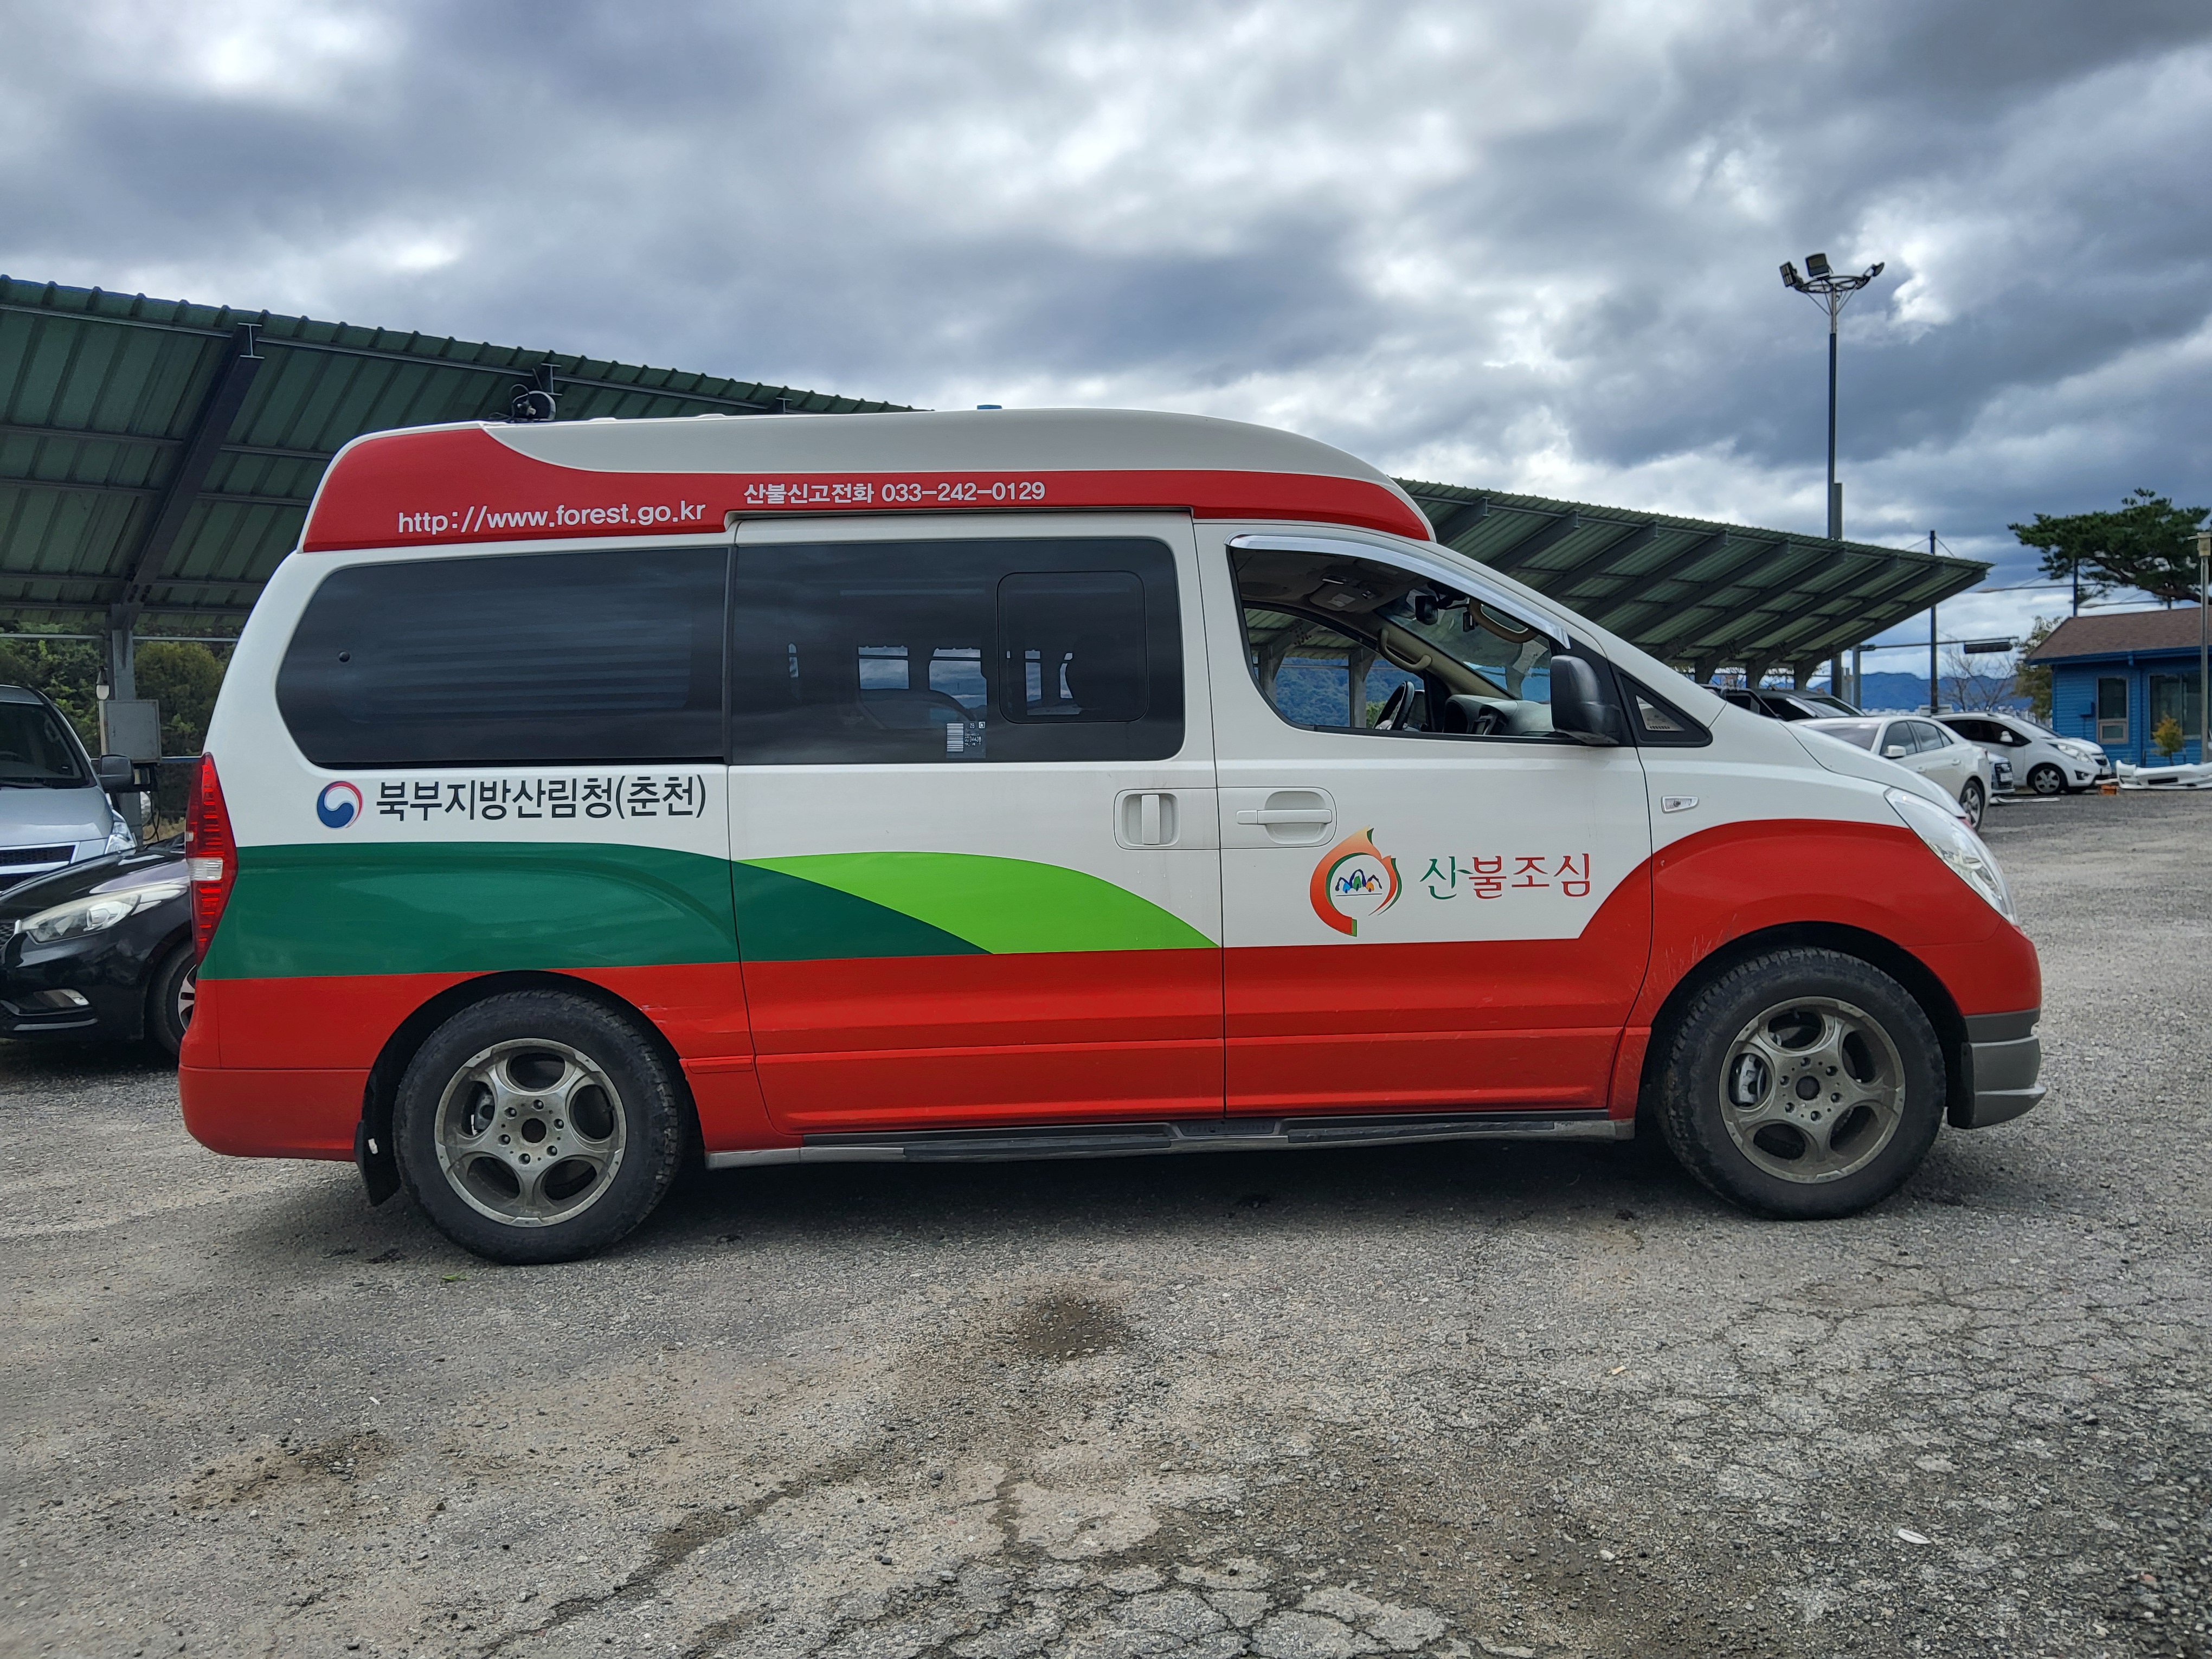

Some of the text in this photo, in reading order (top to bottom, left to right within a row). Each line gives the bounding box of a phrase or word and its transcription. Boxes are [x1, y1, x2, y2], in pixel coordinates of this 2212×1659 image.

[744, 481, 1045, 504] 산불신고전화 033-242-0129
[398, 500, 706, 535] http://www.forest.go.kr
[376, 774, 706, 821] 북부지방산림청(춘천)
[1419, 853, 1591, 900] 산불조심
